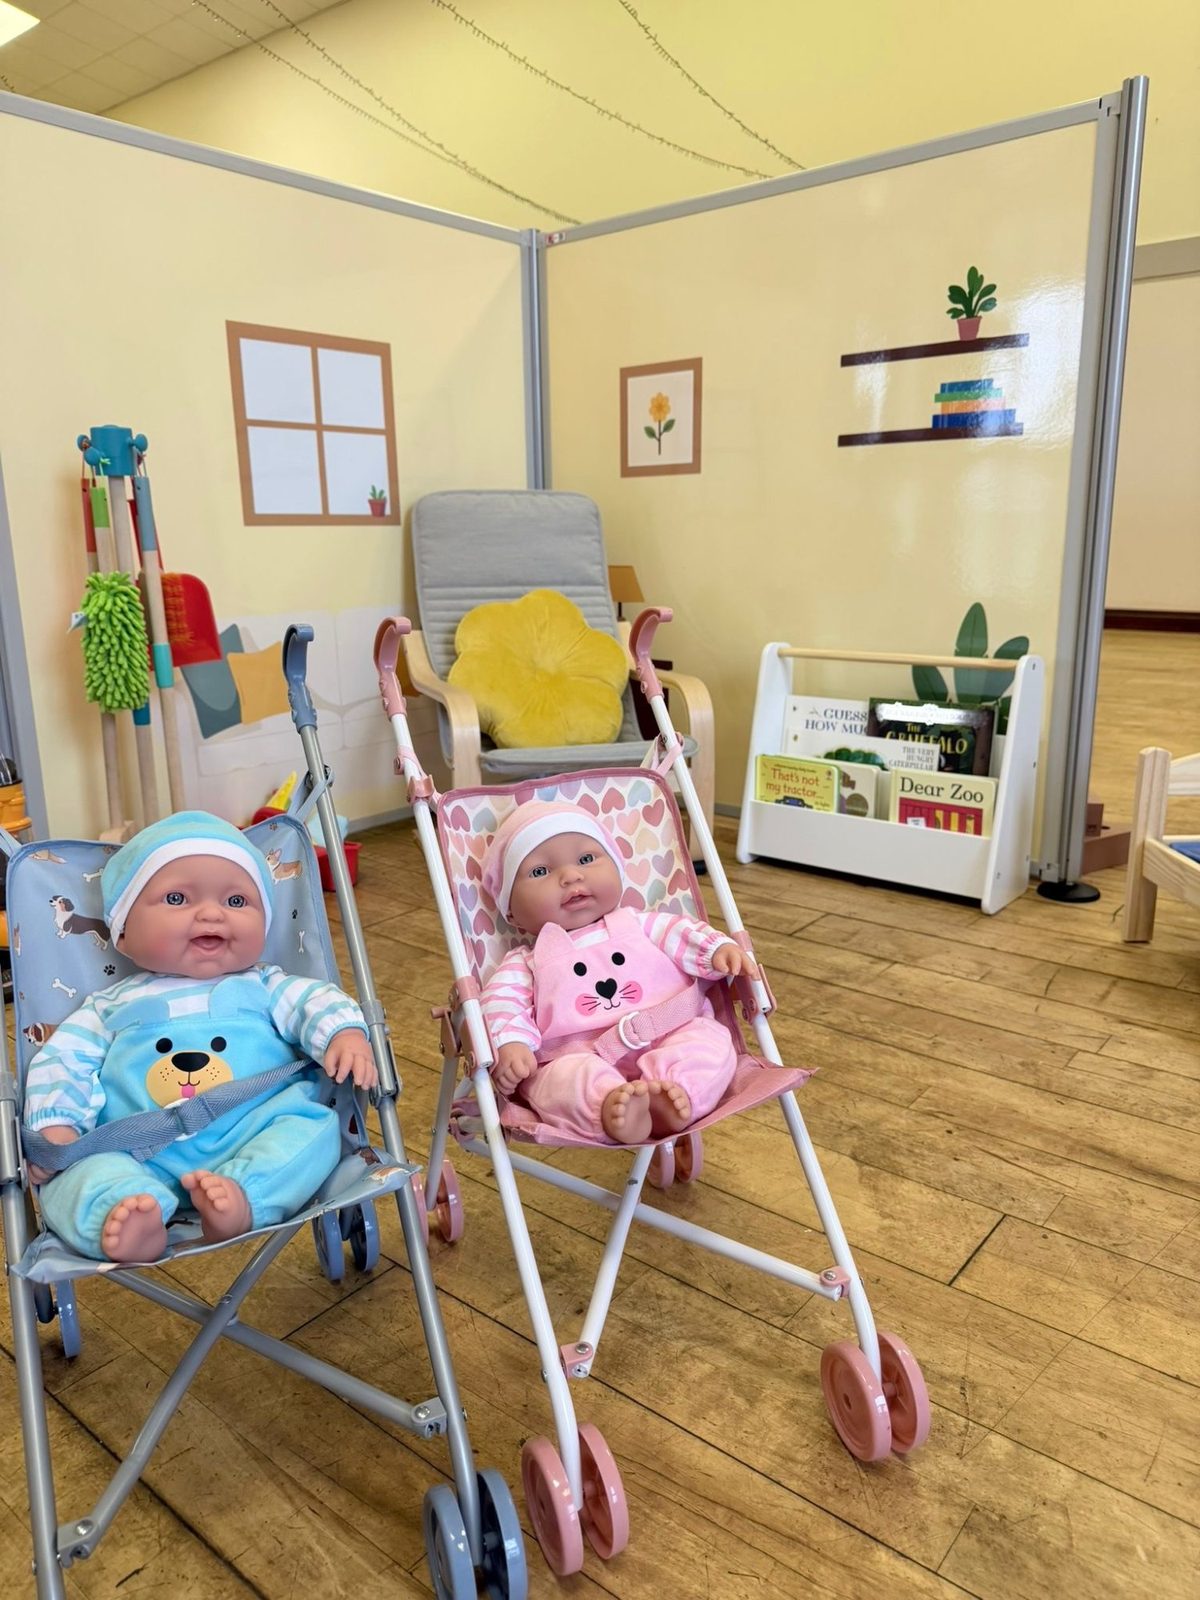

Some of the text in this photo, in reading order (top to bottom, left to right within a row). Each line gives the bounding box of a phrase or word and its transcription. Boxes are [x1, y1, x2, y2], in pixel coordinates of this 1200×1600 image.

[823, 708, 868, 721] GUESS
[805, 719, 838, 731] HOW
[917, 747, 935, 756] VERY
[888, 759, 934, 771] CATERPILLAR
[906, 754, 934, 764] HUNGRY
[771, 767, 800, 783] That's
[802, 776, 819, 786] not
[766, 782, 781, 795] my
[899, 776, 984, 803] Dear Zoo
